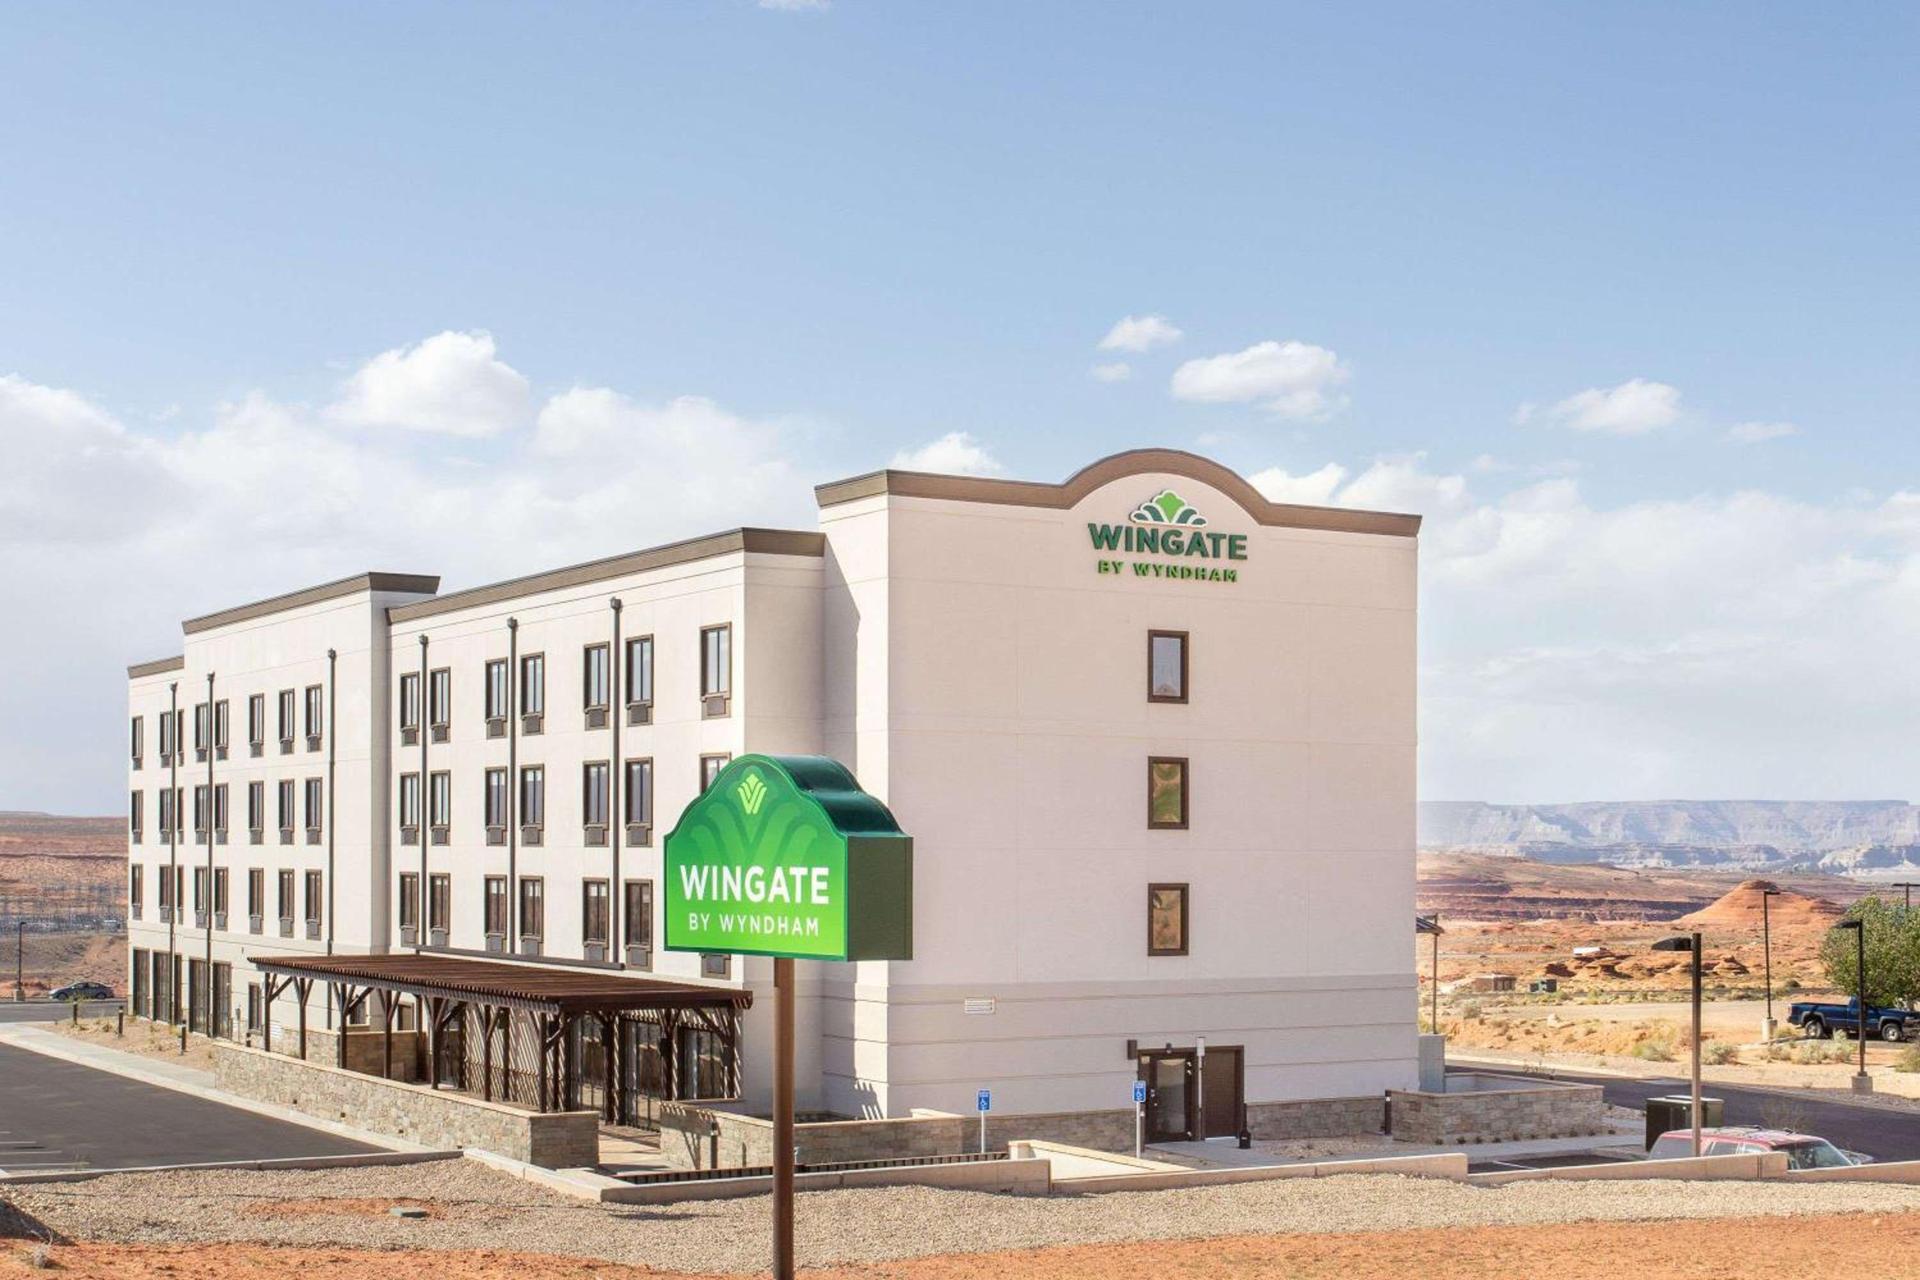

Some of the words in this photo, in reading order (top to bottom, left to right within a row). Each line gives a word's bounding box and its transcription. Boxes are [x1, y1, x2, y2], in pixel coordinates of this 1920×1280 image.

[1088, 523, 1248, 560] WINGATE
[1098, 560, 1124, 574] BY
[1133, 562, 1237, 582] WYNDHAM
[680, 864, 830, 905] WINGATE
[688, 912, 711, 931] BY
[719, 914, 820, 936] WYNDHAM
